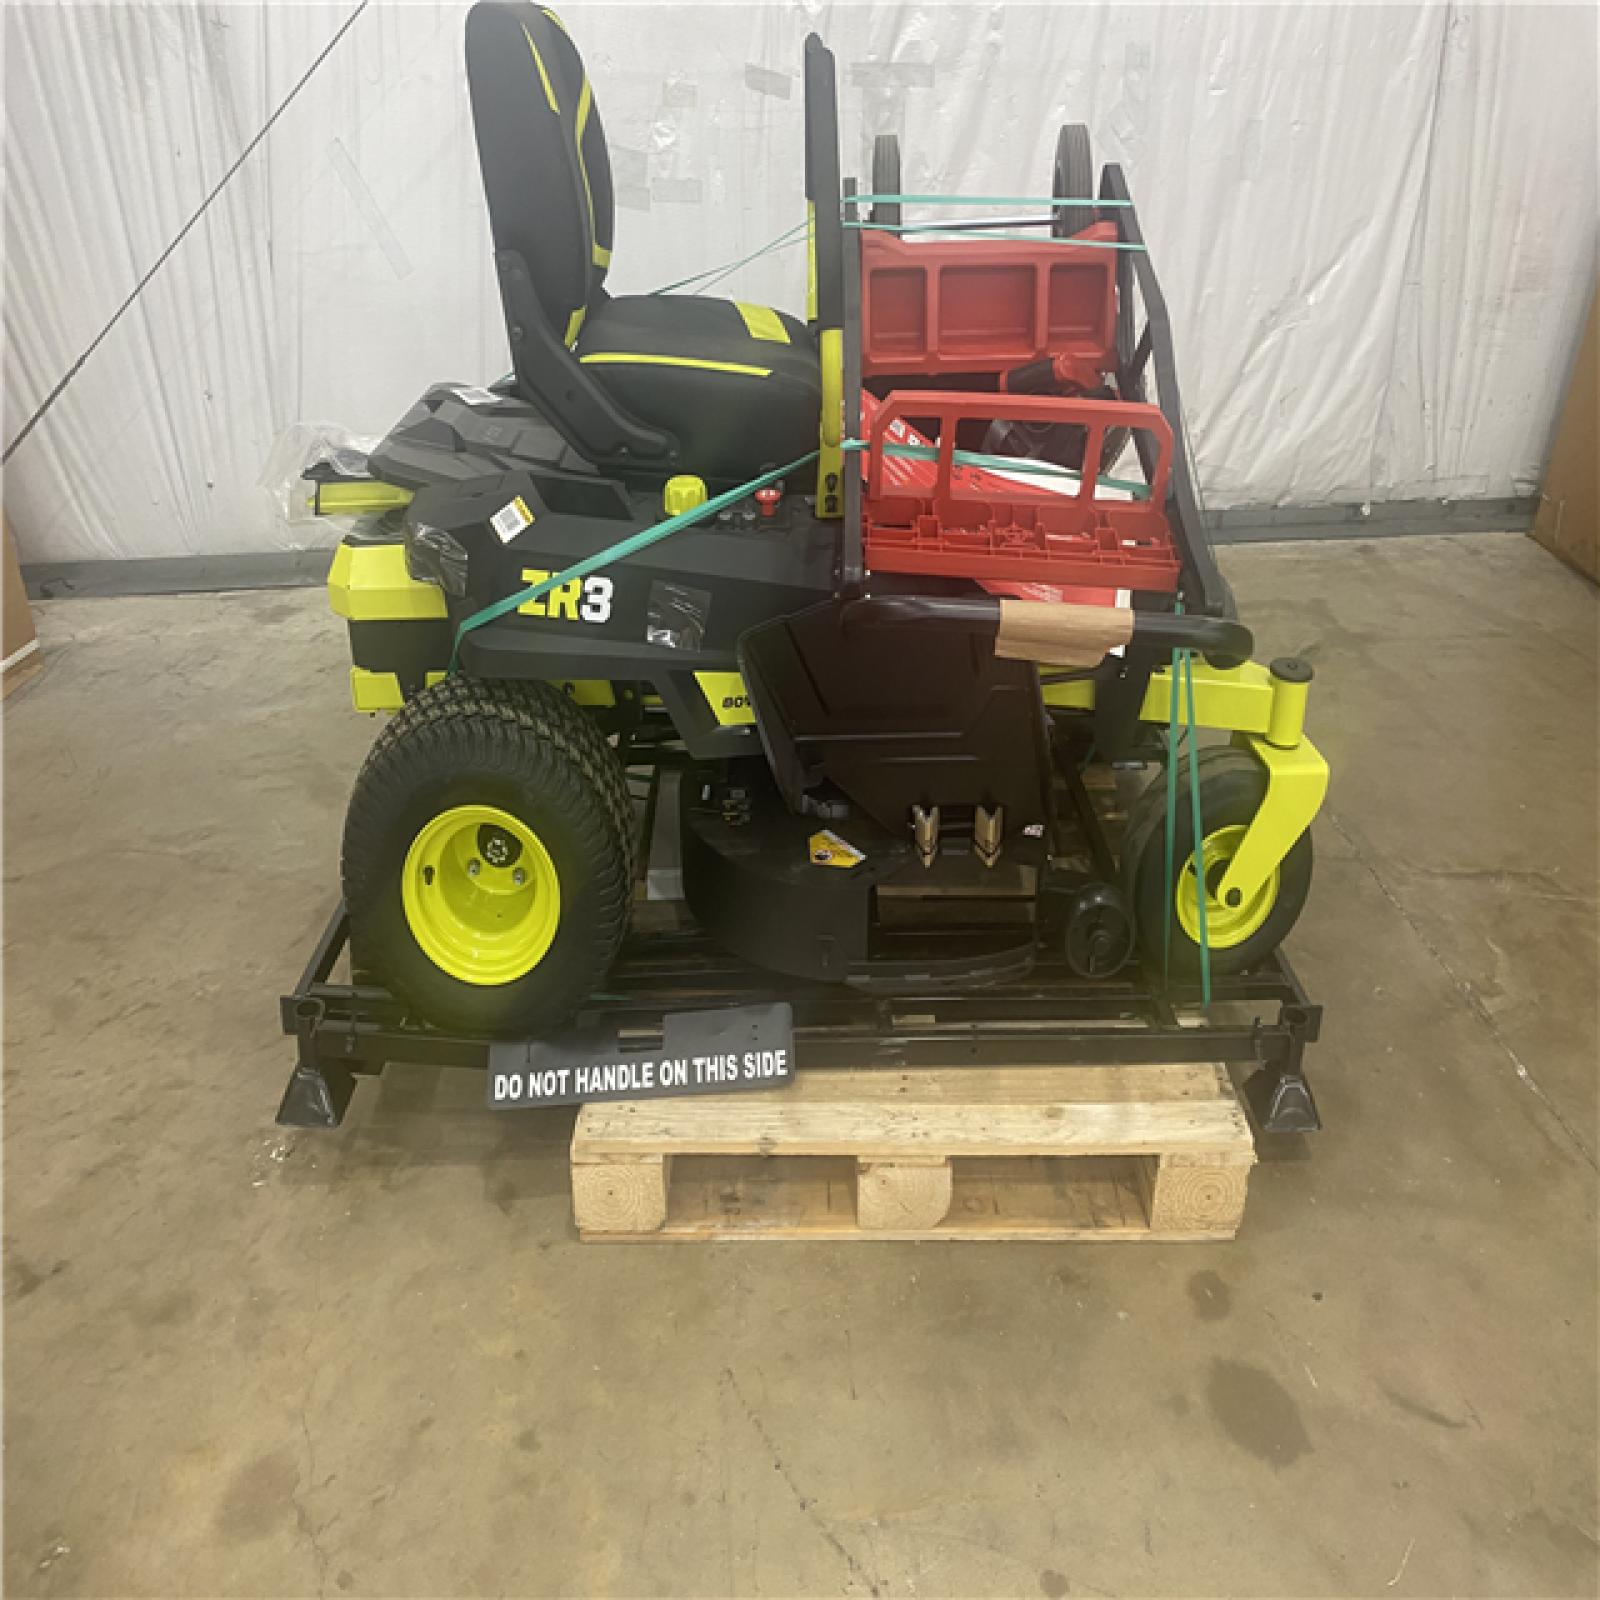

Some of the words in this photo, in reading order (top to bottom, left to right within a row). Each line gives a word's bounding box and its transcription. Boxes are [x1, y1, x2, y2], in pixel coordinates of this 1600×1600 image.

[518, 569, 613, 623] ZR3
[494, 1074, 522, 1101] DO
[529, 1069, 570, 1098] NOT
[574, 1062, 655, 1094] HANDLE
[660, 1059, 688, 1086] ON
[692, 1054, 738, 1083] THIS
[743, 1049, 788, 1078] SIDE
